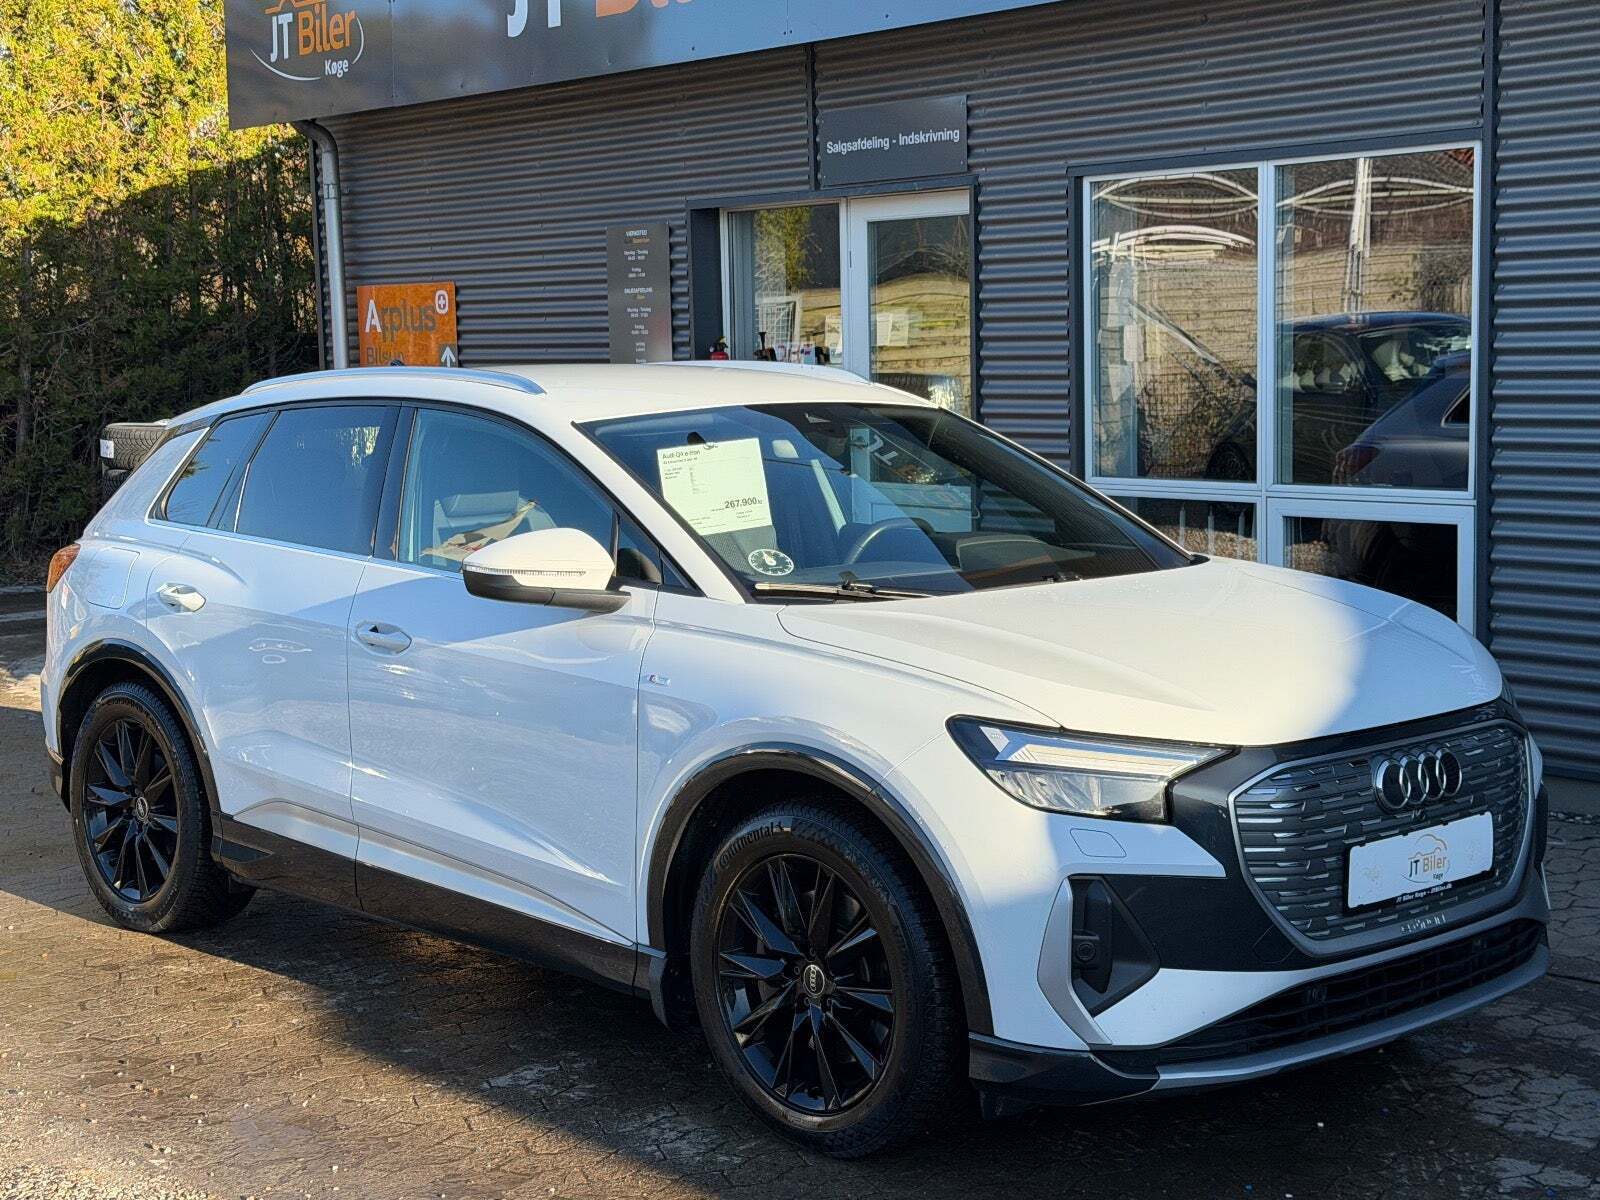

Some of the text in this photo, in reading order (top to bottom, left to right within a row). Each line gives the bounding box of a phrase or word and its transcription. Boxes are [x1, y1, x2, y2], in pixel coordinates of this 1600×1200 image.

[270, 3, 356, 63] JT Biler
[324, 59, 349, 78] Køge
[826, 136, 890, 155] Salgsafdeling
[899, 128, 960, 147] Indskrivning
[724, 496, 757, 509] 267.900
[718, 822, 774, 869] Continental
[1409, 855, 1446, 877] JT Biler
